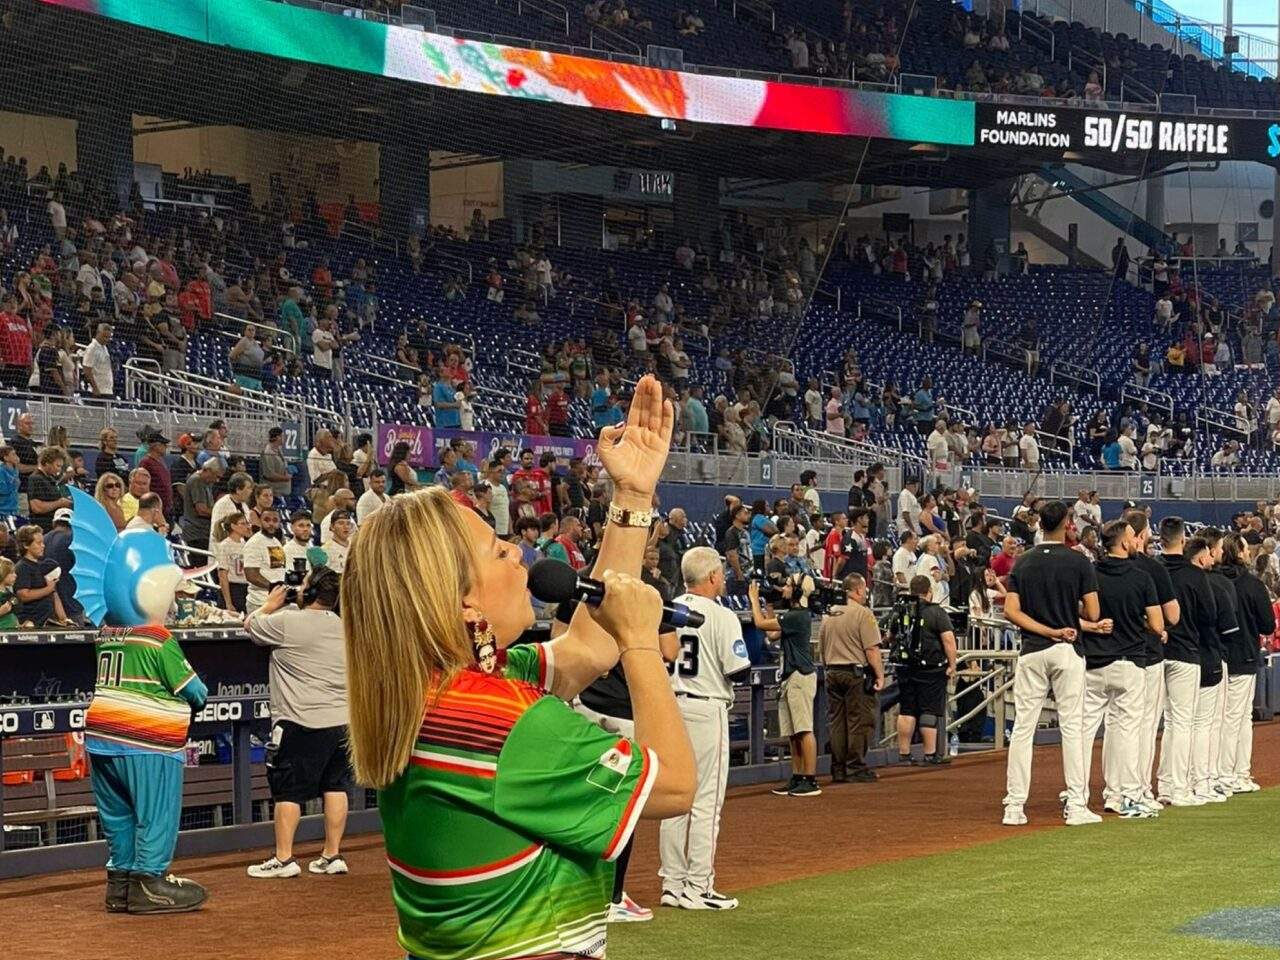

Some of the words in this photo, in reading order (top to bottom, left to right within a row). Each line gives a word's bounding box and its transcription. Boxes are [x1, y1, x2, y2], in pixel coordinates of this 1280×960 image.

[996, 110, 1056, 128] MARLINS
[980, 129, 1070, 147] FOUNDATION
[1084, 114, 1153, 152] 50/50
[1158, 120, 1229, 154] RAFFLE
[285, 429, 298, 450] 22
[1143, 480, 1153, 494] 25
